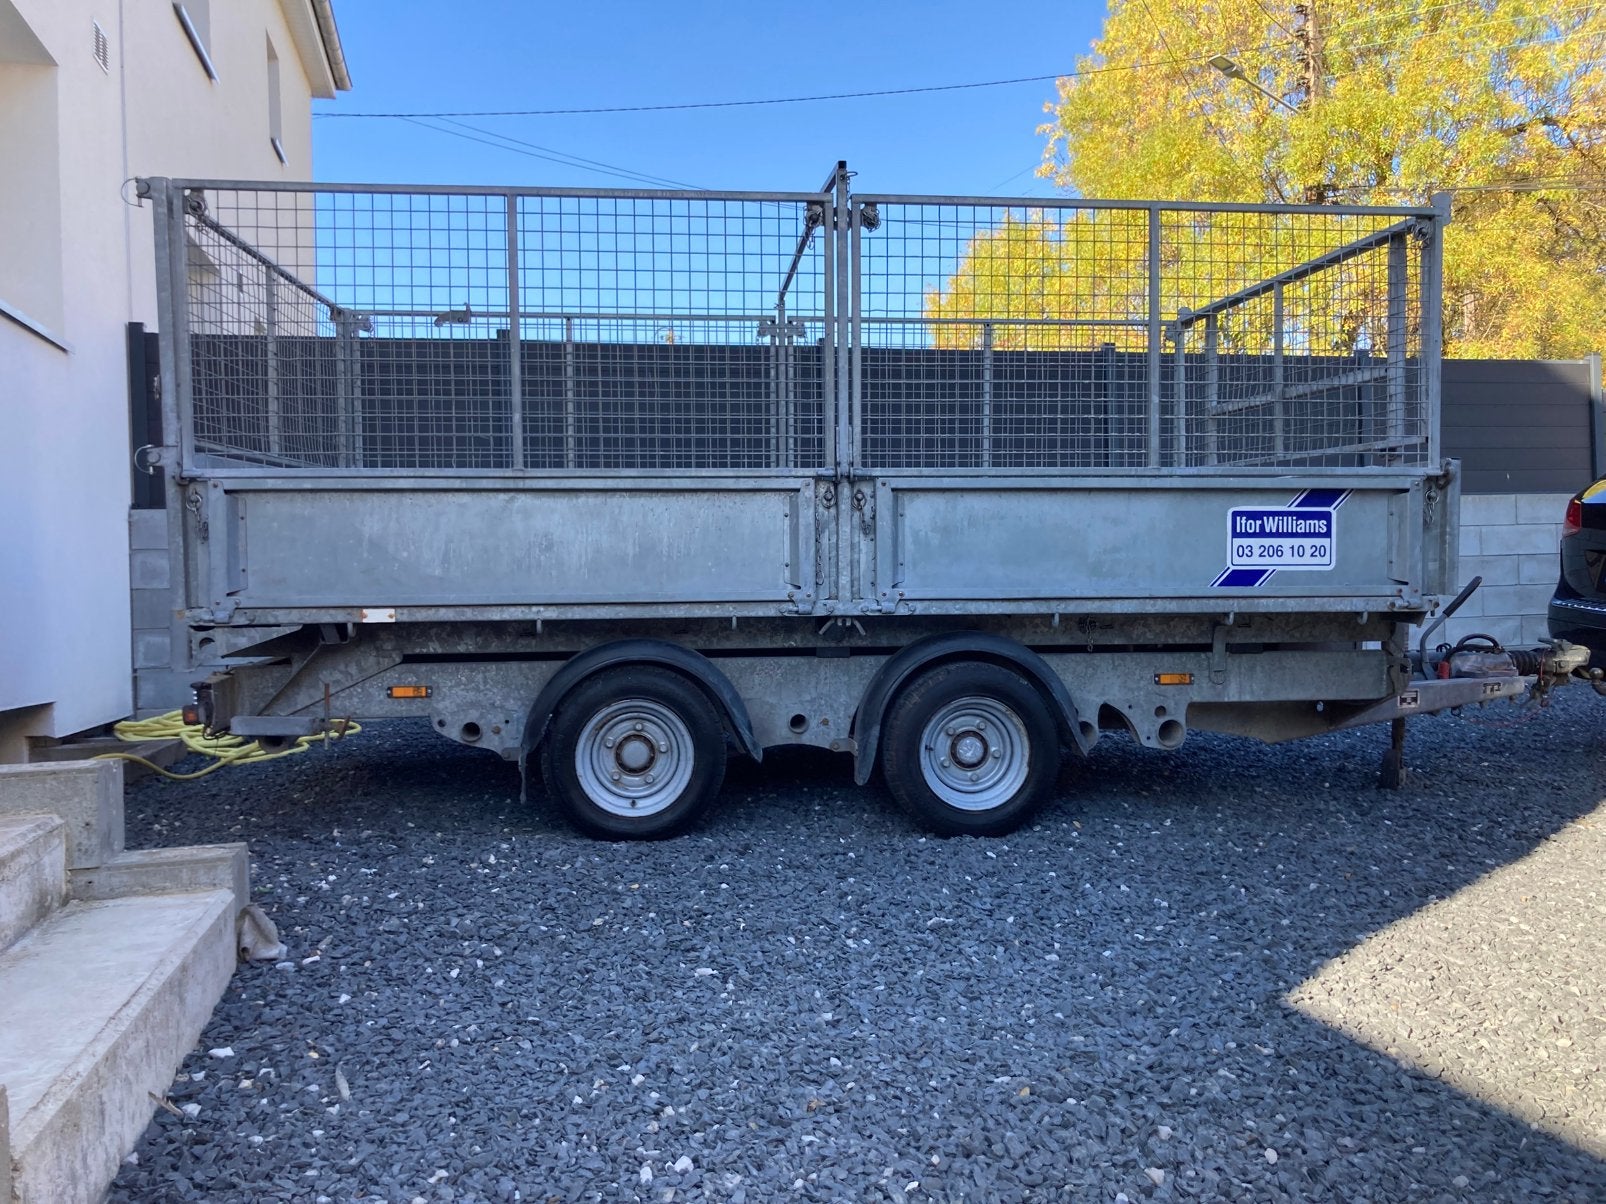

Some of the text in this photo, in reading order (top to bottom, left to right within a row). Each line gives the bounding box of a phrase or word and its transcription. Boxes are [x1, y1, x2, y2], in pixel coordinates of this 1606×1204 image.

[1236, 516, 1327, 533] Ifor Williams
[1236, 545, 1327, 558] 03 206 10 20
